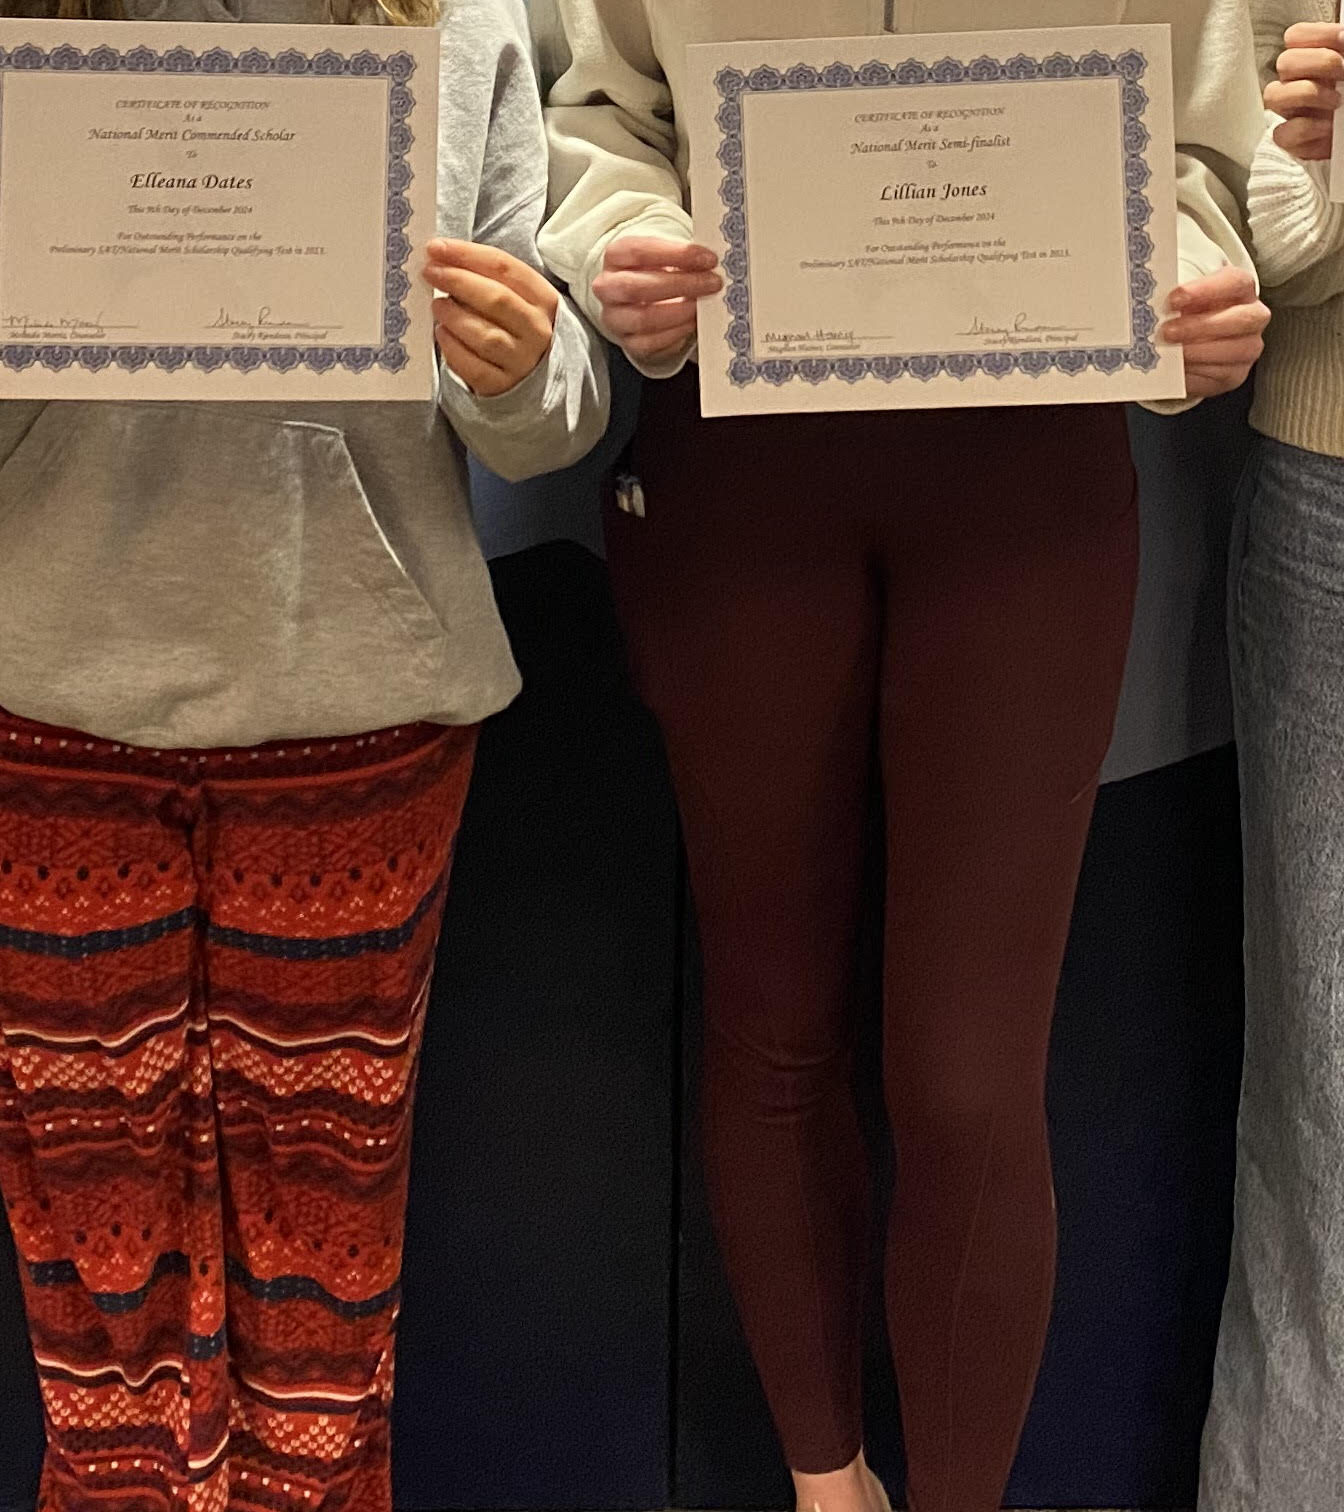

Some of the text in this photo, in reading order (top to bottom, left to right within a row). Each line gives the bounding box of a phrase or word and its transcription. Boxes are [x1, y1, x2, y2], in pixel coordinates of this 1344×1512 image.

[88, 128, 296, 141] National Merit Commended Scholar
[850, 135, 1011, 154] National Merit Semi-finalist
[130, 172, 253, 189] Elleana Dates
[881, 182, 987, 201] Lillian Jones
